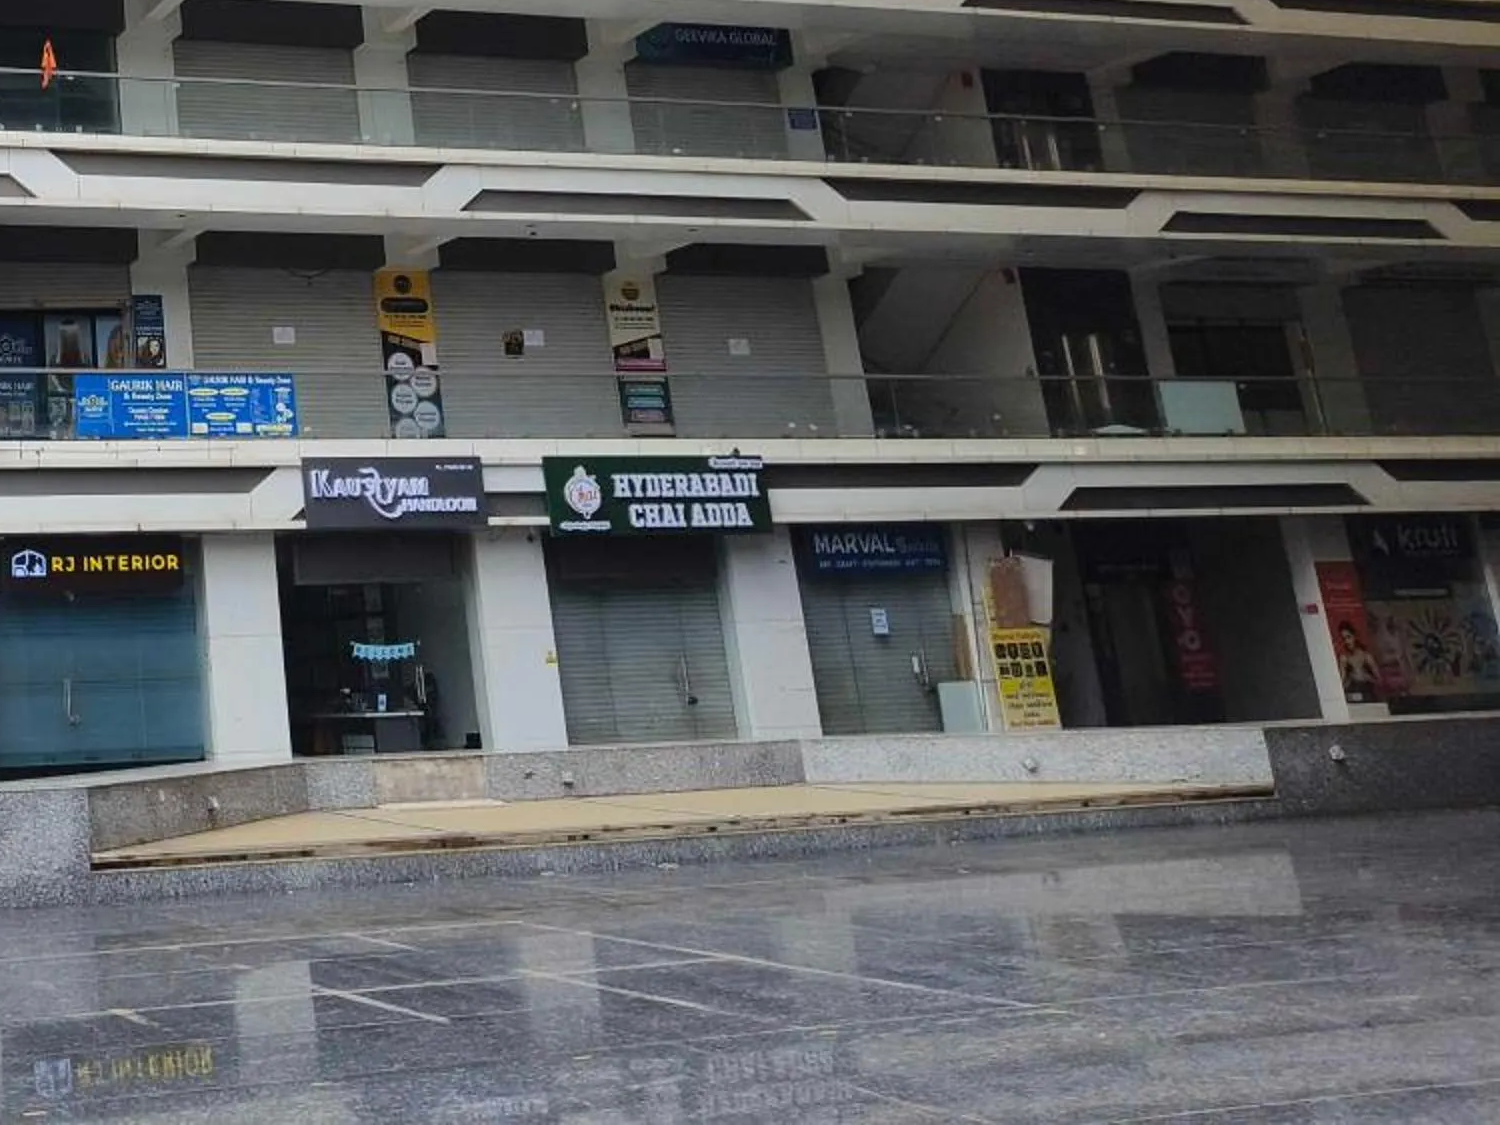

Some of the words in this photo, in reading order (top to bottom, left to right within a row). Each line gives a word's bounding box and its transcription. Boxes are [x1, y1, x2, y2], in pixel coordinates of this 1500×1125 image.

[611, 473, 760, 498] HYDERABADI
[628, 503, 687, 528] CHAI
[691, 503, 754, 528] ADDA
[813, 532, 896, 554] MARVAL
[51, 556, 75, 572] RJ
[83, 554, 179, 572] INTERIOR
